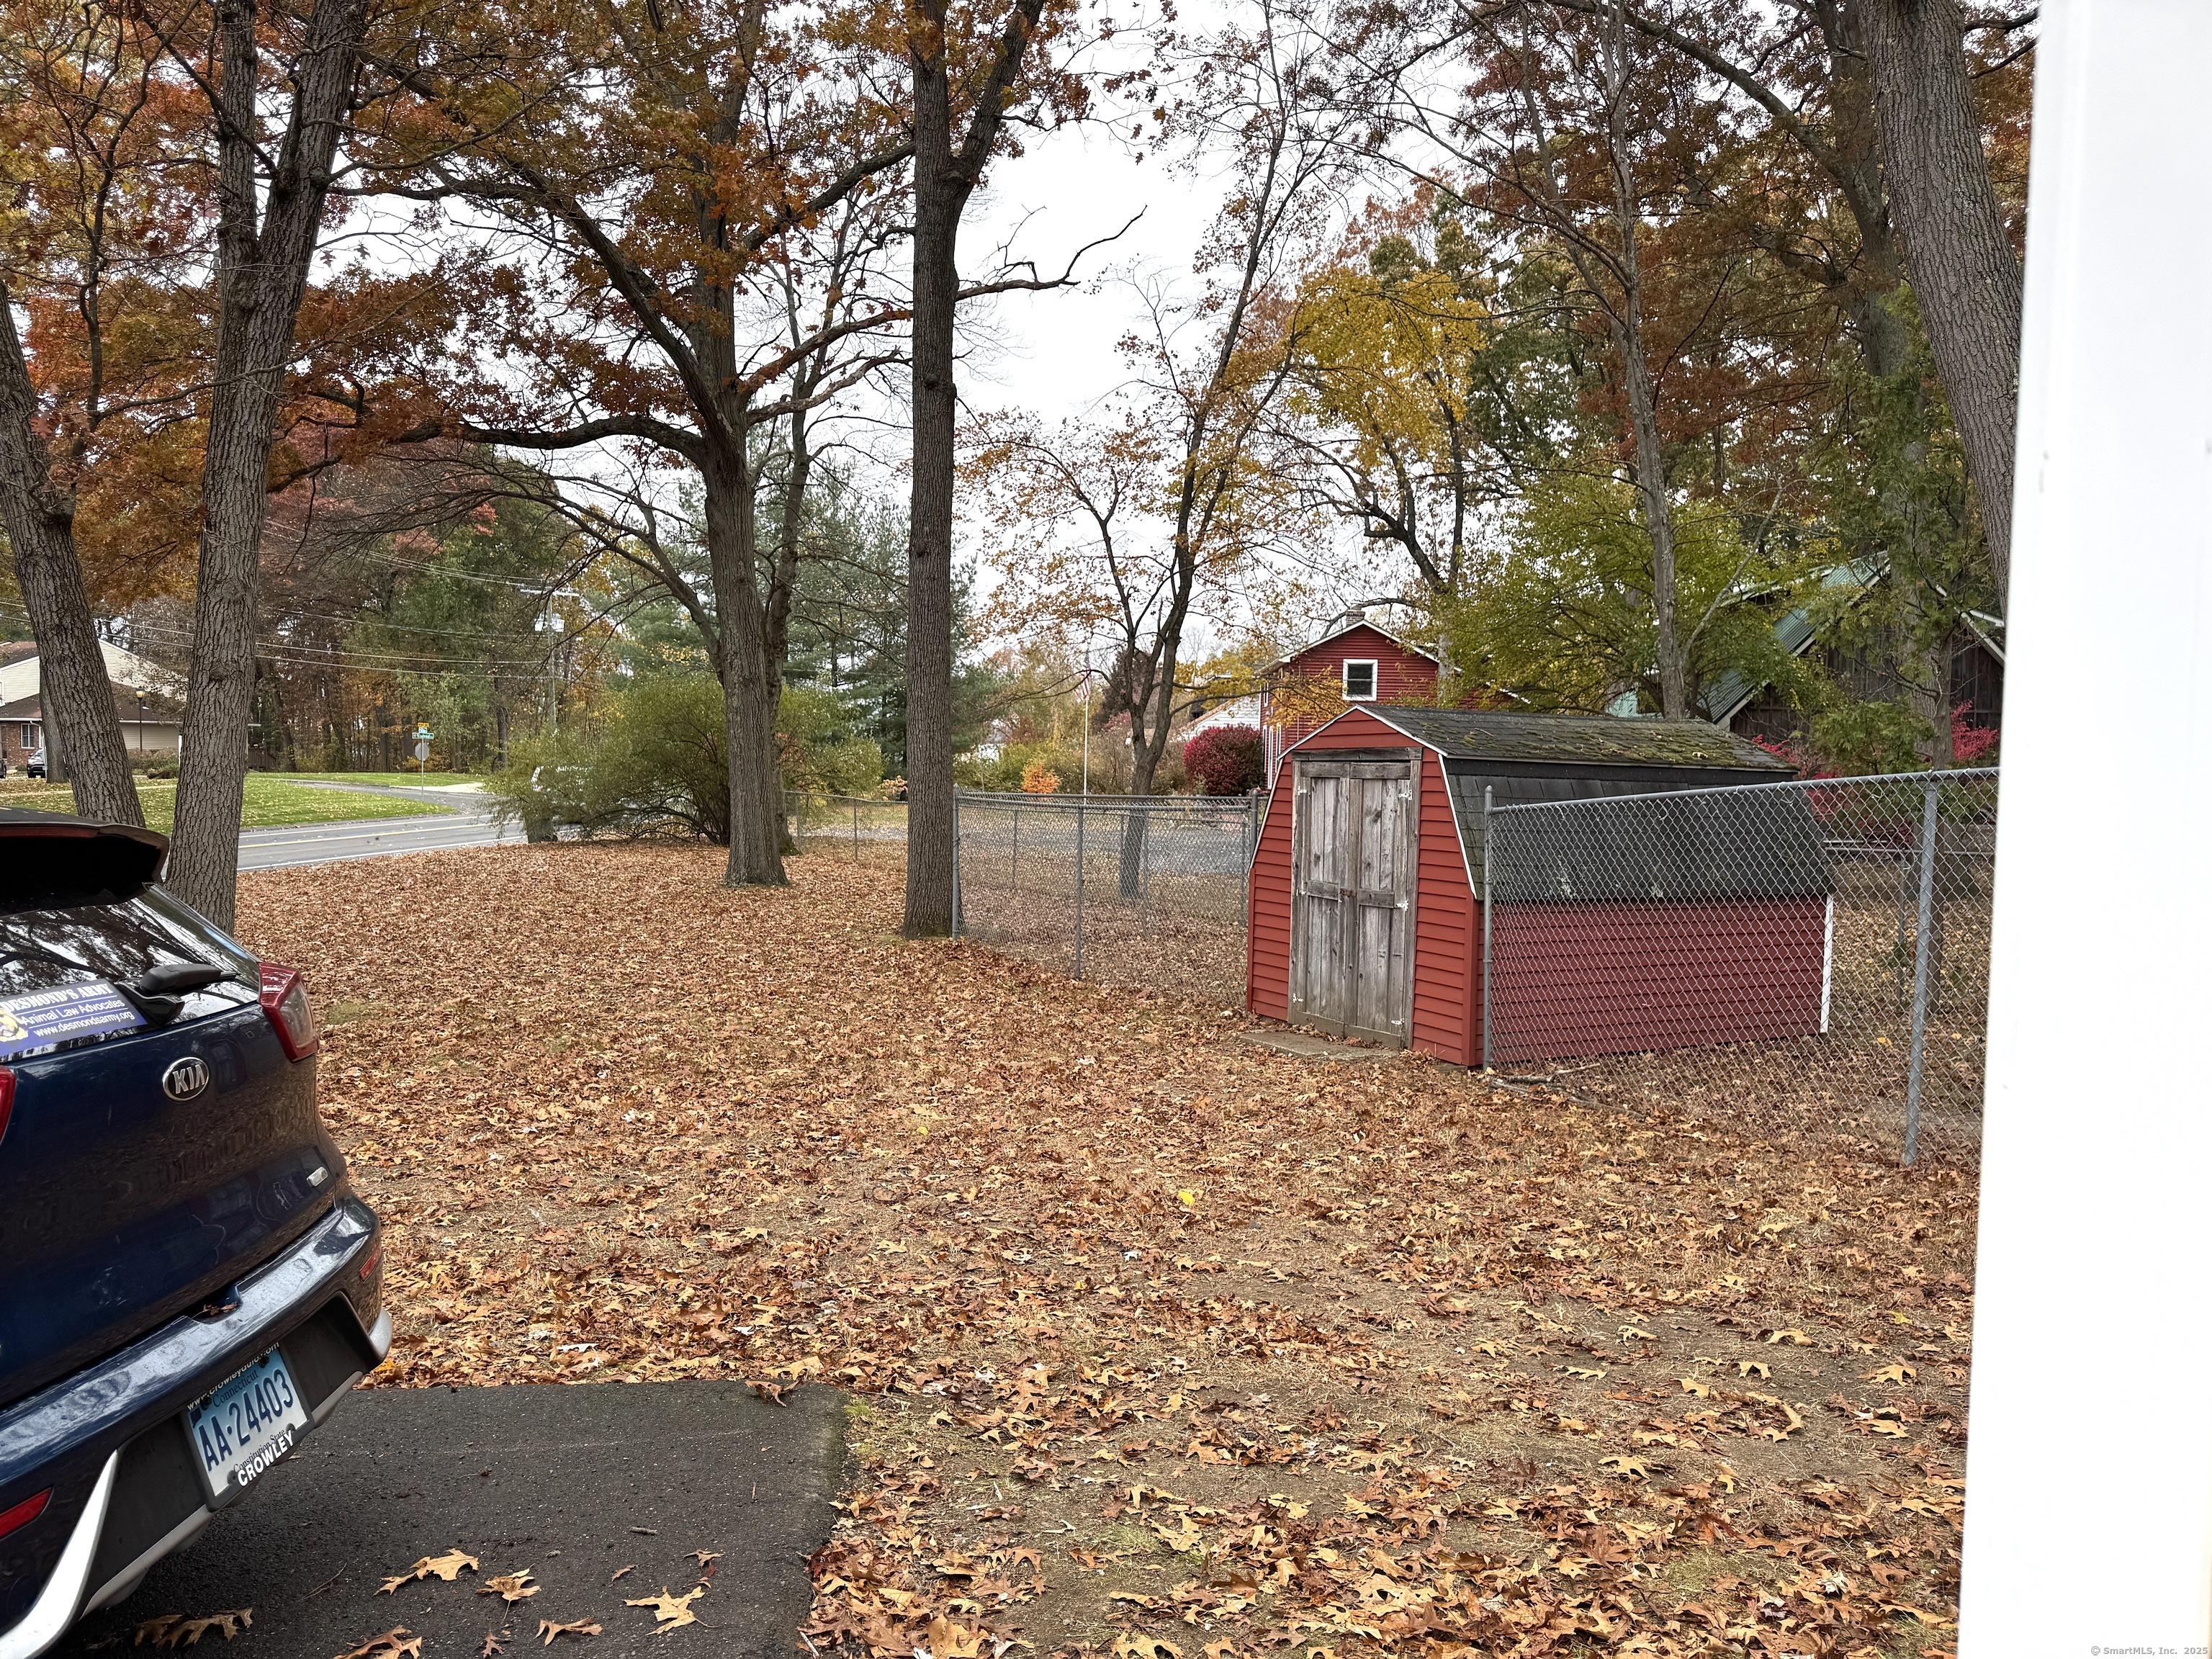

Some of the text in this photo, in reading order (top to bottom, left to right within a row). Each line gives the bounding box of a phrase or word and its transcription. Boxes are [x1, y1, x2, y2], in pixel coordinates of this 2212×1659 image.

[0, 983, 114, 1012] DESMOND'S ARMY
[21, 998, 125, 1026] Animal Law Advocates
[33, 1010, 135, 1037] www.desmondsarmy.org
[172, 1064, 205, 1094] KIA
[212, 1370, 259, 1408] Connecticut
[238, 1429, 294, 1486] CROWLEY
